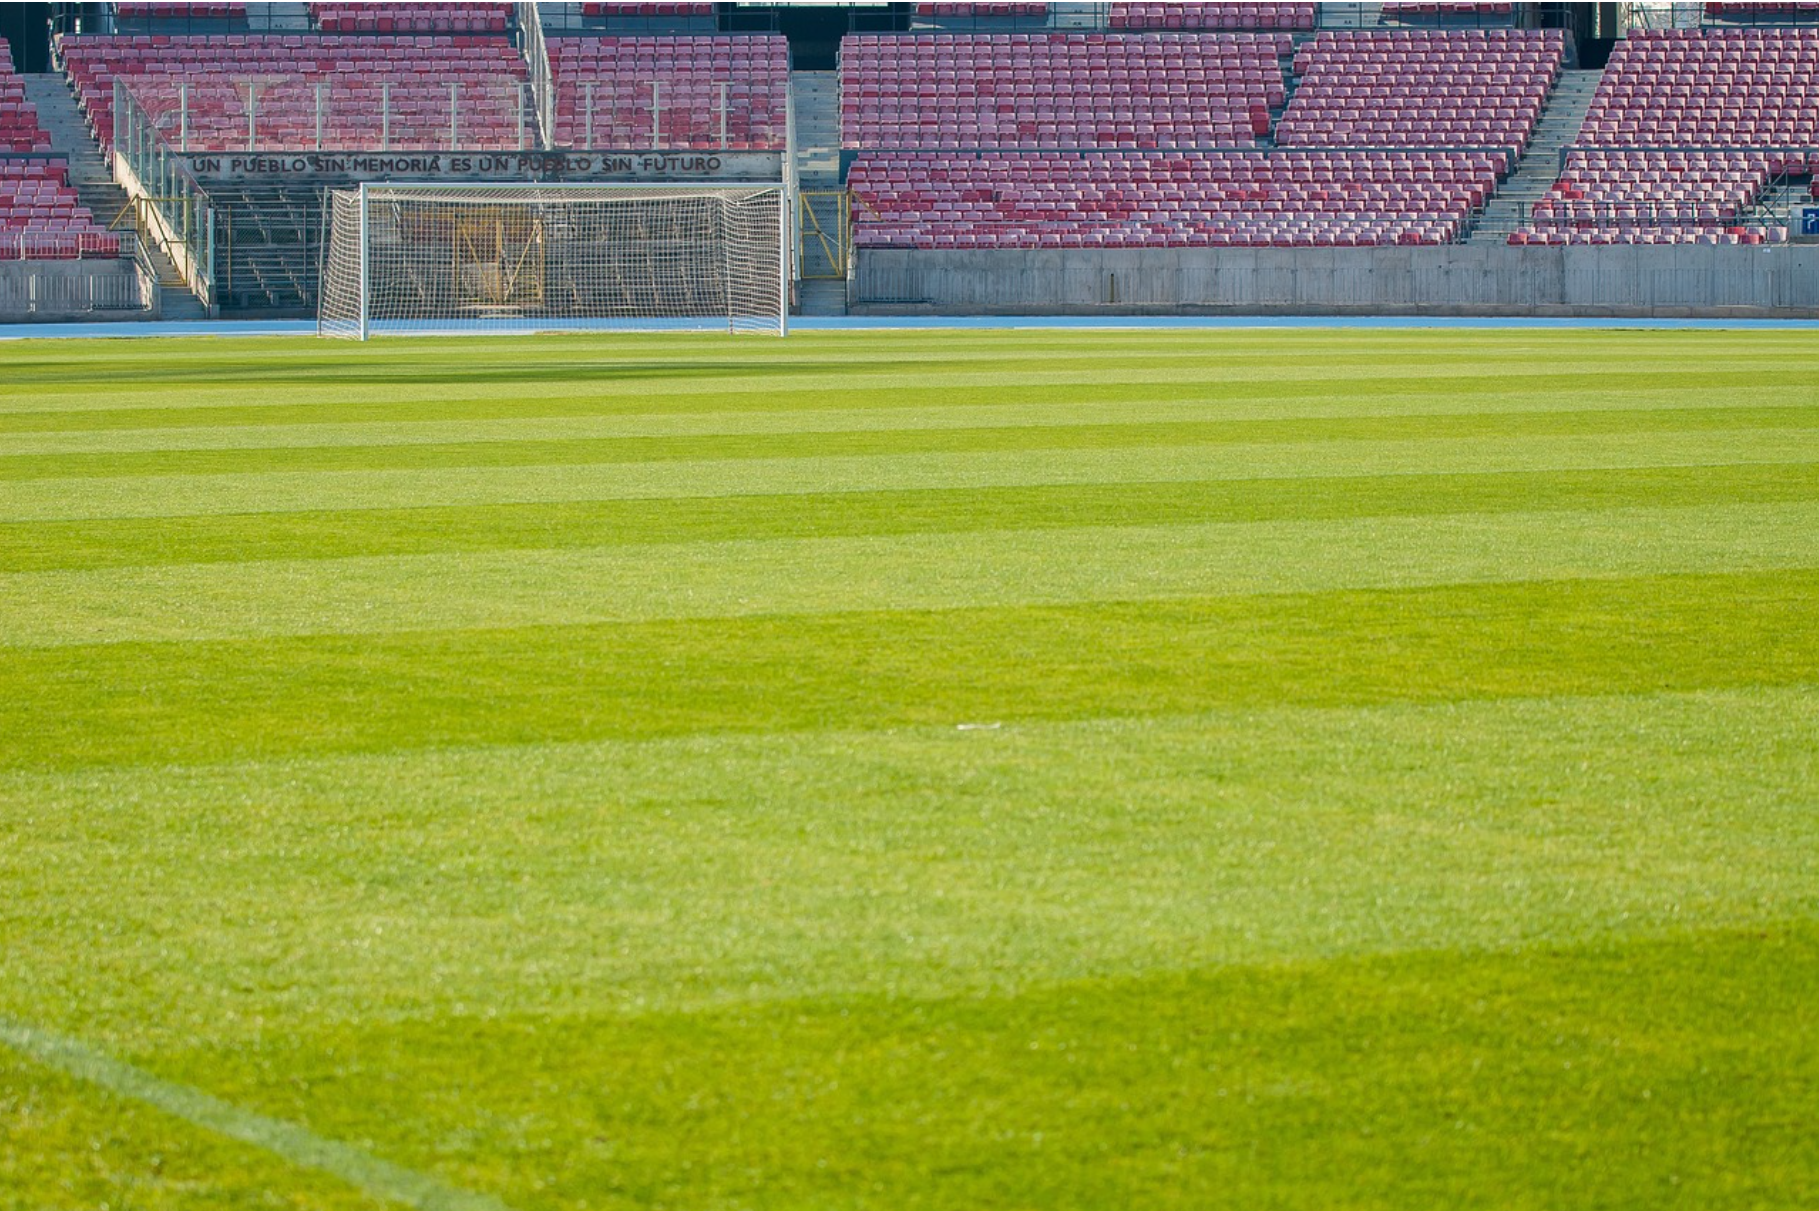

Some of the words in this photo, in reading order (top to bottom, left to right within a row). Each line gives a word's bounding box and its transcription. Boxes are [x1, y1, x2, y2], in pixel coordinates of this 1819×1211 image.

[193, 159, 220, 172] UN
[232, 159, 306, 172] PUEBLO
[315, 159, 345, 172] SIN
[451, 158, 472, 171] ES
[479, 158, 508, 171] UN
[518, 158, 591, 171] PUEBLO
[602, 158, 632, 171] SIN
[643, 157, 721, 171] FUTURO
